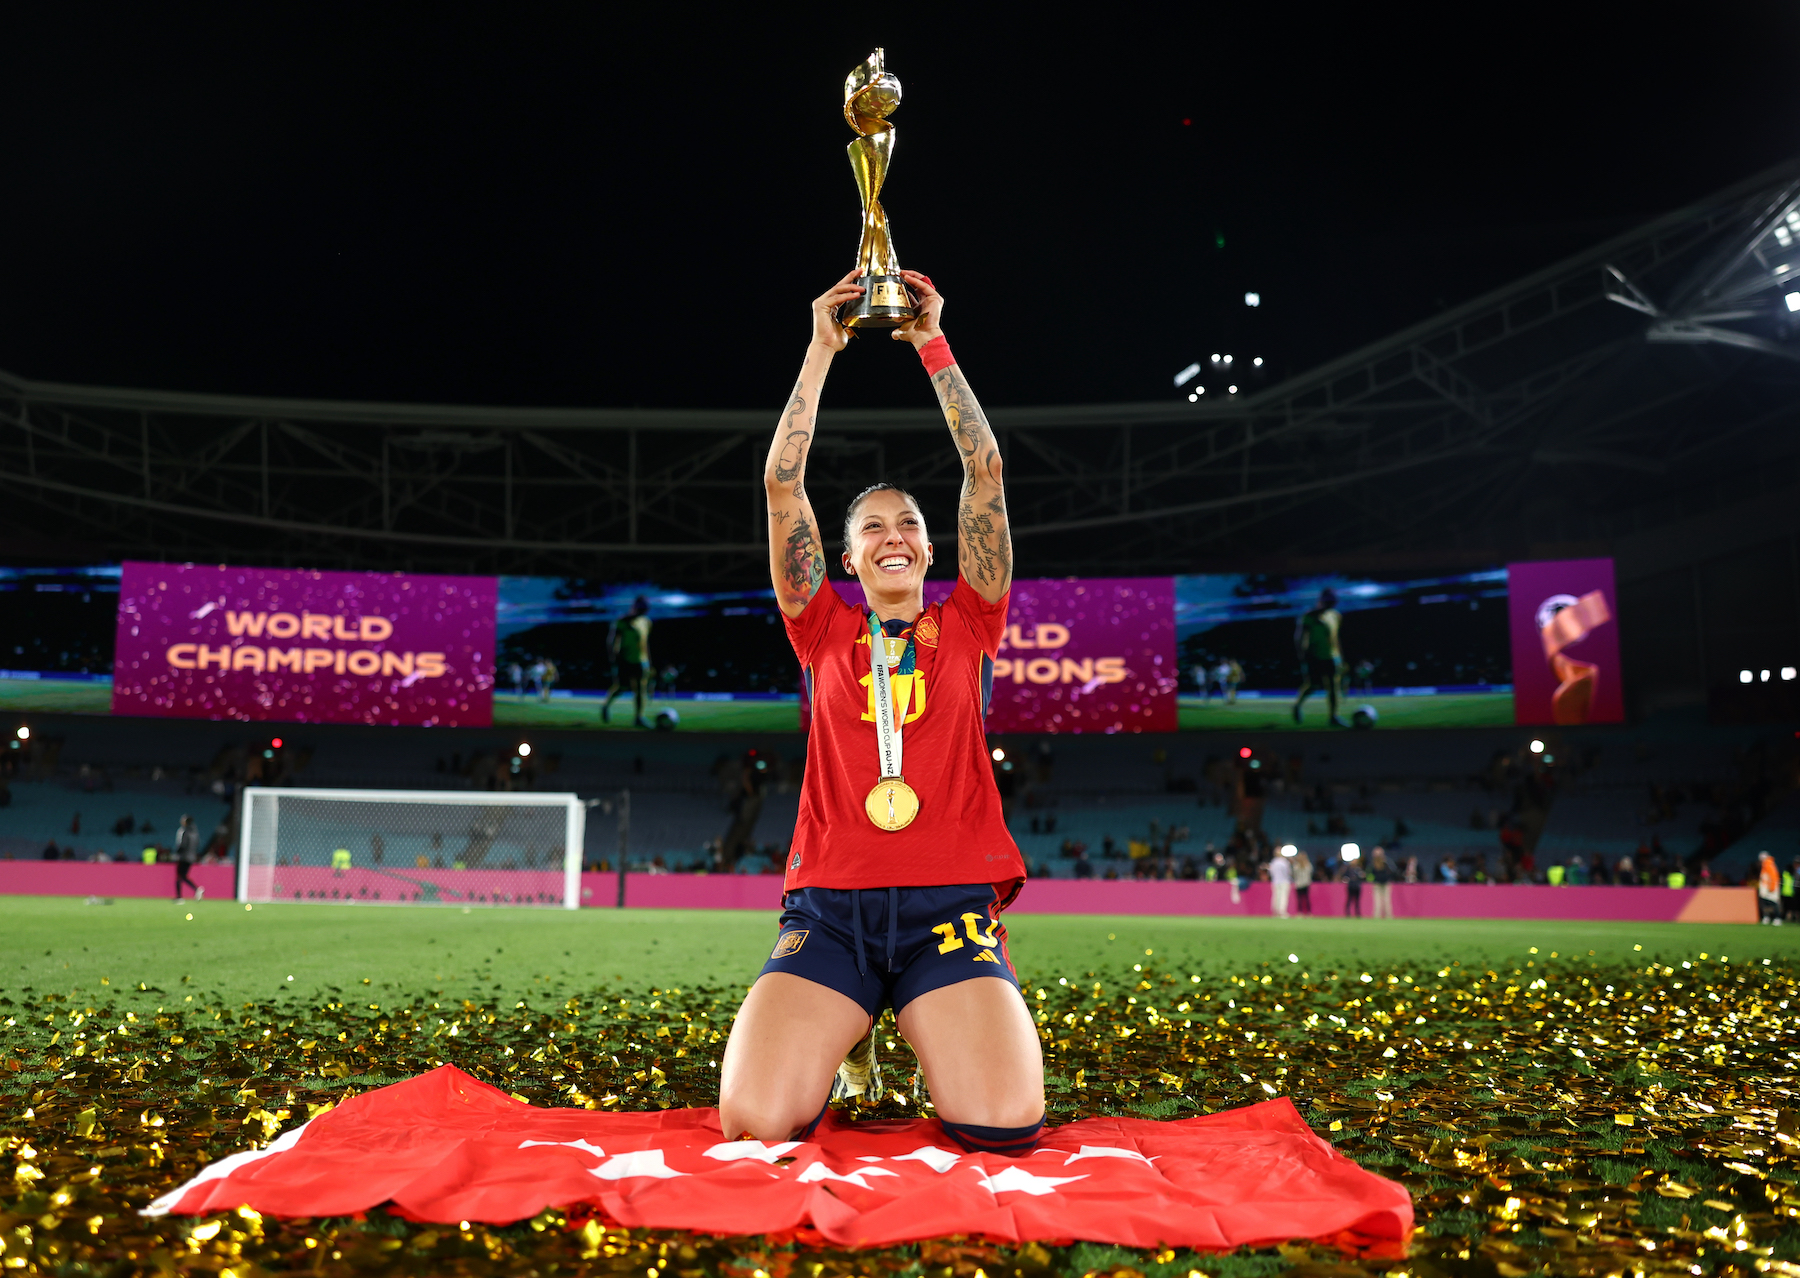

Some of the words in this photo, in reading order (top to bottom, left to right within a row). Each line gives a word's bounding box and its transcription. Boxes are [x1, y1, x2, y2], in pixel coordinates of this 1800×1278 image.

[877, 285, 905, 295] FIA
[224, 609, 394, 643] WORLD
[166, 643, 446, 678] CHAMPIONS
[876, 664, 884, 677] FIFA
[879, 677, 888, 708] WOMEN'S
[882, 709, 890, 734] WORLD
[883, 734, 891, 750] CUP
[931, 912, 999, 955] 10
